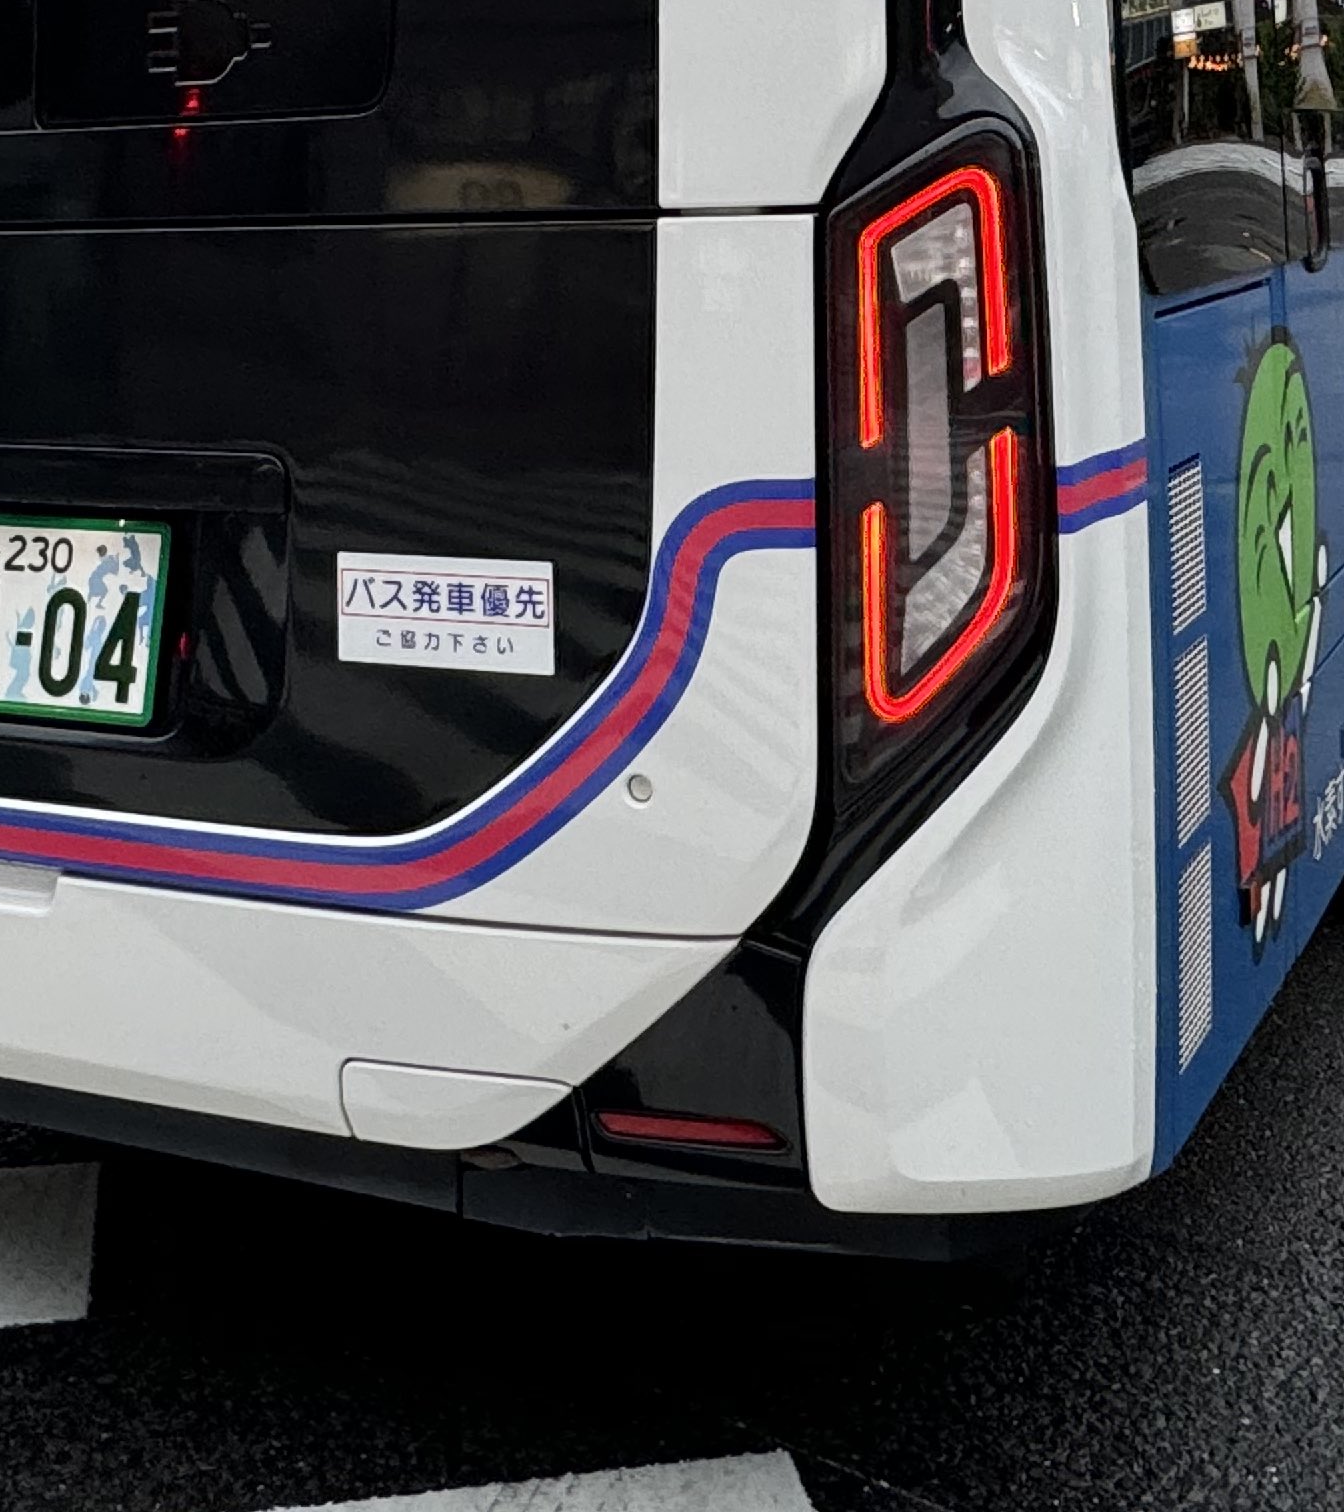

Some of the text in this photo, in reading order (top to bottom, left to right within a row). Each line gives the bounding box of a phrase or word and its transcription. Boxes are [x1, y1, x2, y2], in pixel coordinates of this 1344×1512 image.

[345, 576, 545, 620] バス発車優先
[376, 629, 514, 655] ご協力下さい
